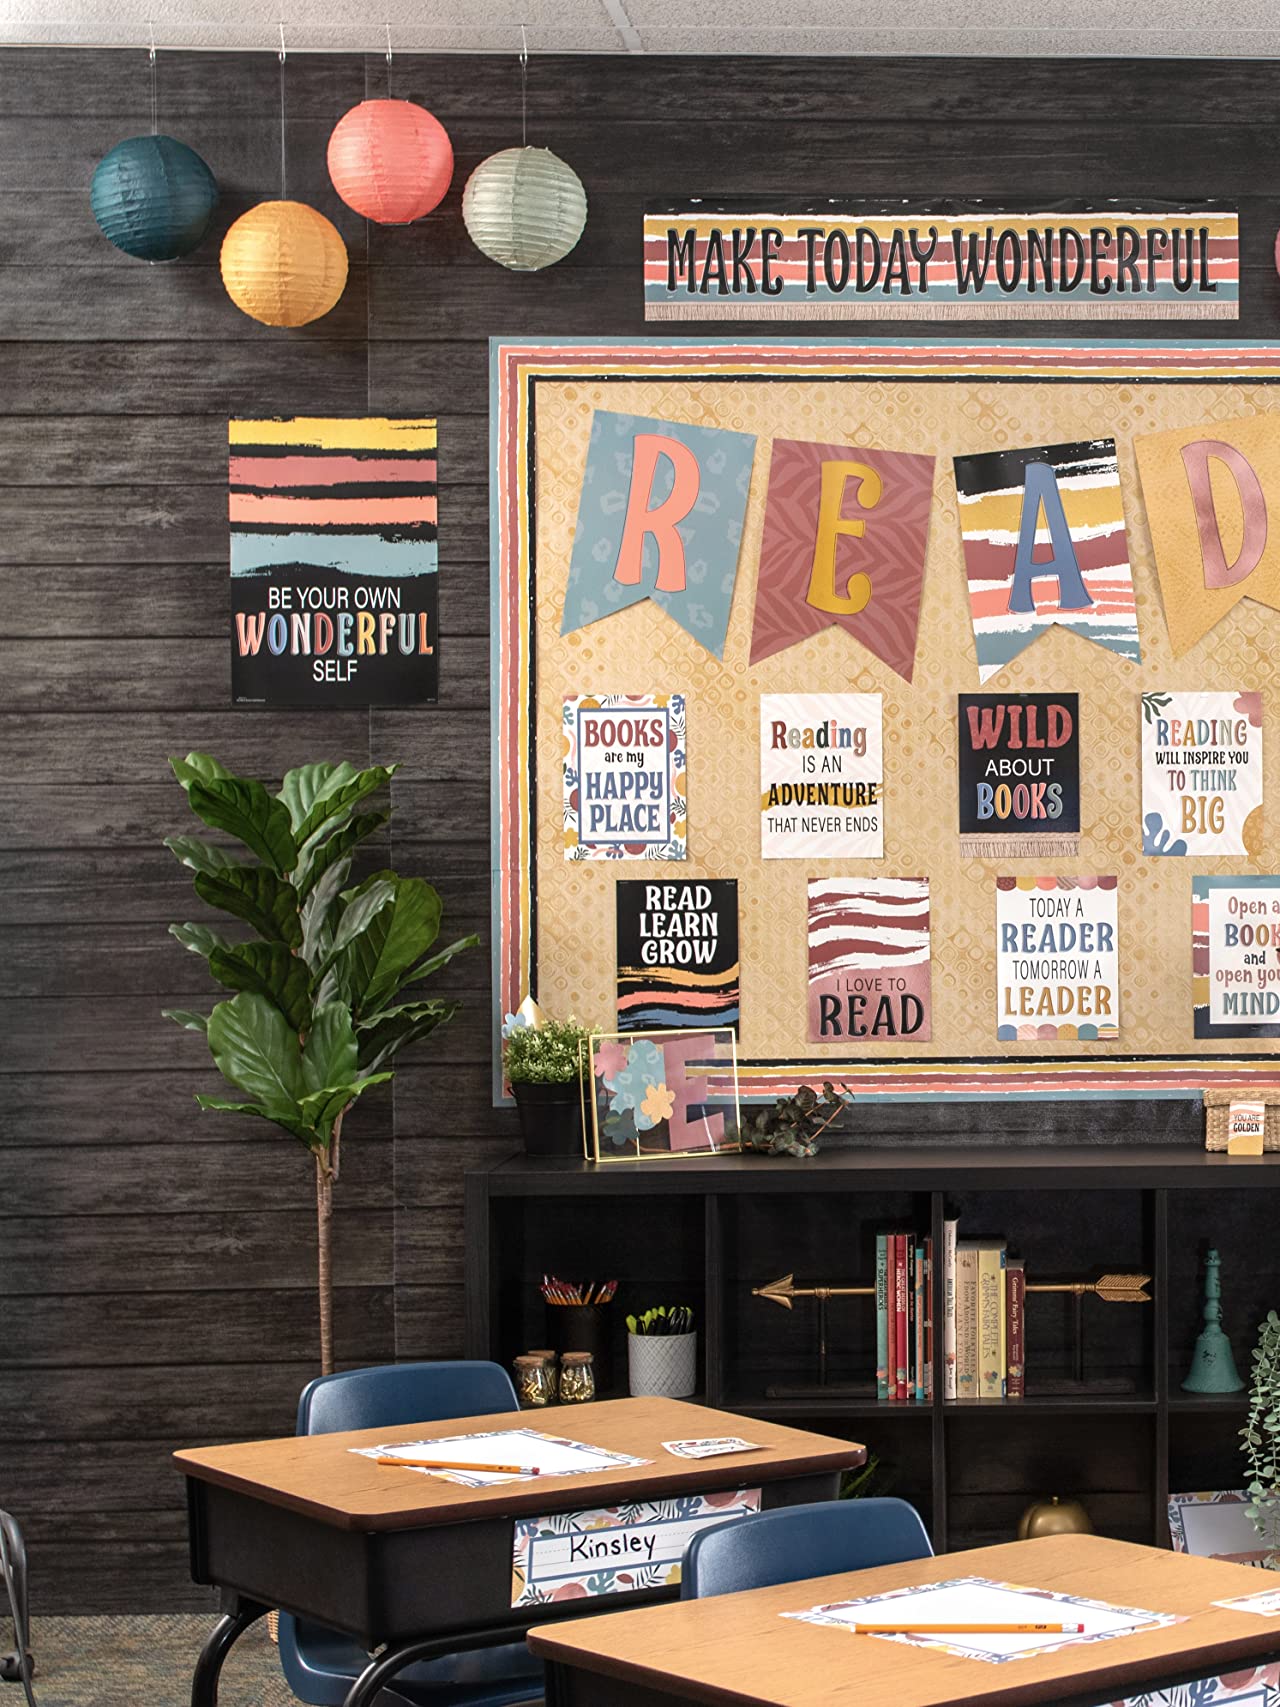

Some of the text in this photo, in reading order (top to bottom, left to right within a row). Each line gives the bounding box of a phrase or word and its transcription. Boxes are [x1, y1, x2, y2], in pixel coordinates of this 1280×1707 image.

[665, 225, 1219, 298] MAKE TODAY WONDERFUL
[611, 431, 1269, 616] READ
[268, 586, 401, 609] BE YOUR OWN
[234, 611, 434, 657] WONDERFUL
[312, 659, 358, 682] SELF
[583, 717, 665, 750] BOOKS
[770, 719, 868, 758] Reading
[966, 703, 1074, 751] WILD
[1156, 718, 1248, 747] READING
[604, 752, 645, 769] are my
[801, 755, 843, 774] IS AN
[984, 758, 1056, 778] ABOUT
[1155, 751, 1249, 765] WILL INSPIRE YOU
[585, 771, 664, 802] HAPPY
[1167, 769, 1237, 791] TO THINK
[767, 781, 879, 807] ADVENTURE
[976, 782, 1064, 821] BOOKS
[589, 803, 661, 833] PLACE
[767, 816, 879, 834] THAT NEVER ENDS
[1180, 795, 1225, 834] BIG
[645, 885, 713, 912] READ
[1029, 897, 1084, 918] TODAY A
[1227, 895, 1280, 920] Open a
[639, 912, 719, 939] LEARN
[1001, 922, 1114, 953] READER
[640, 938, 717, 966] GROW
[1243, 950, 1266, 965] and
[1012, 959, 1102, 980] TOMORROW A
[1215, 968, 1253, 988] open
[836, 977, 908, 993] I LOVE TO
[1004, 985, 1112, 1016] LEADER
[819, 993, 925, 1037] READ
[1233, 1122, 1260, 1133] GOLDEN
[1234, 1114, 1260, 1122] YOU ARE
[983, 1309, 991, 1329] FAIRY
[1010, 1304, 1019, 1318] Fairy
[983, 1333, 991, 1359] TALES
[963, 1346, 971, 1375] WORLD
[570, 1533, 656, 1562] Kinsley
